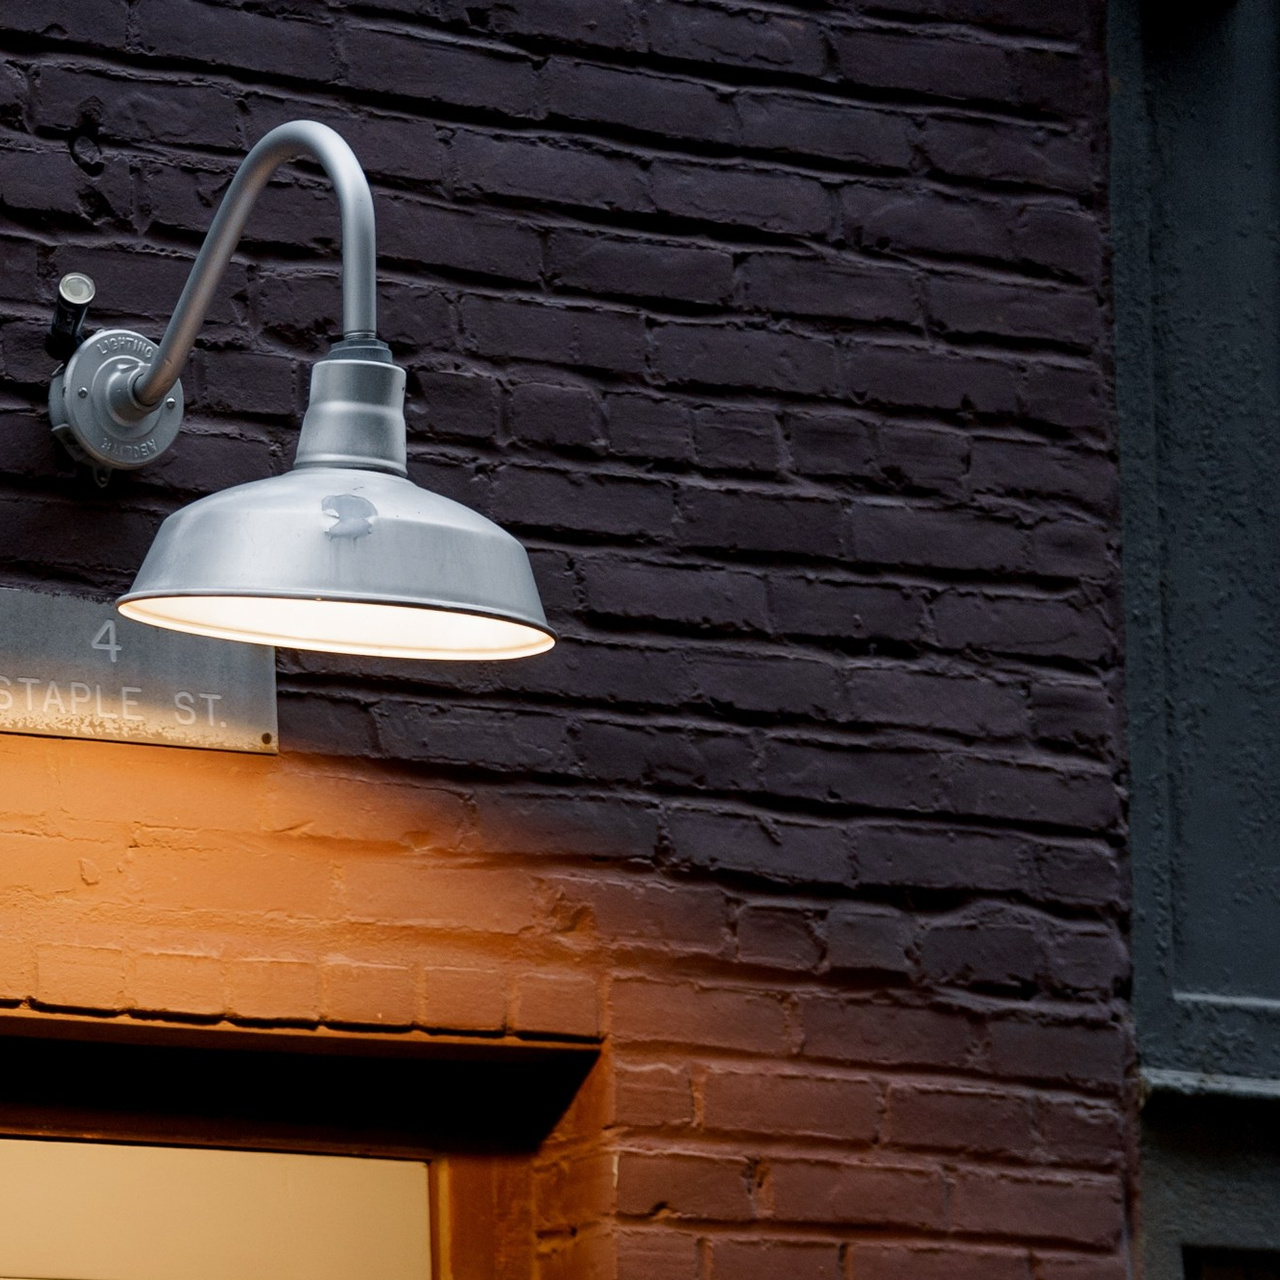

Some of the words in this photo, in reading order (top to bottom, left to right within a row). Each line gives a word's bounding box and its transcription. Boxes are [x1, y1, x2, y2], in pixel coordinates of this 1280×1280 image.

[96, 336, 154, 358] LIGHTING
[90, 619, 122, 662] 4
[174, 691, 227, 728] ST.
